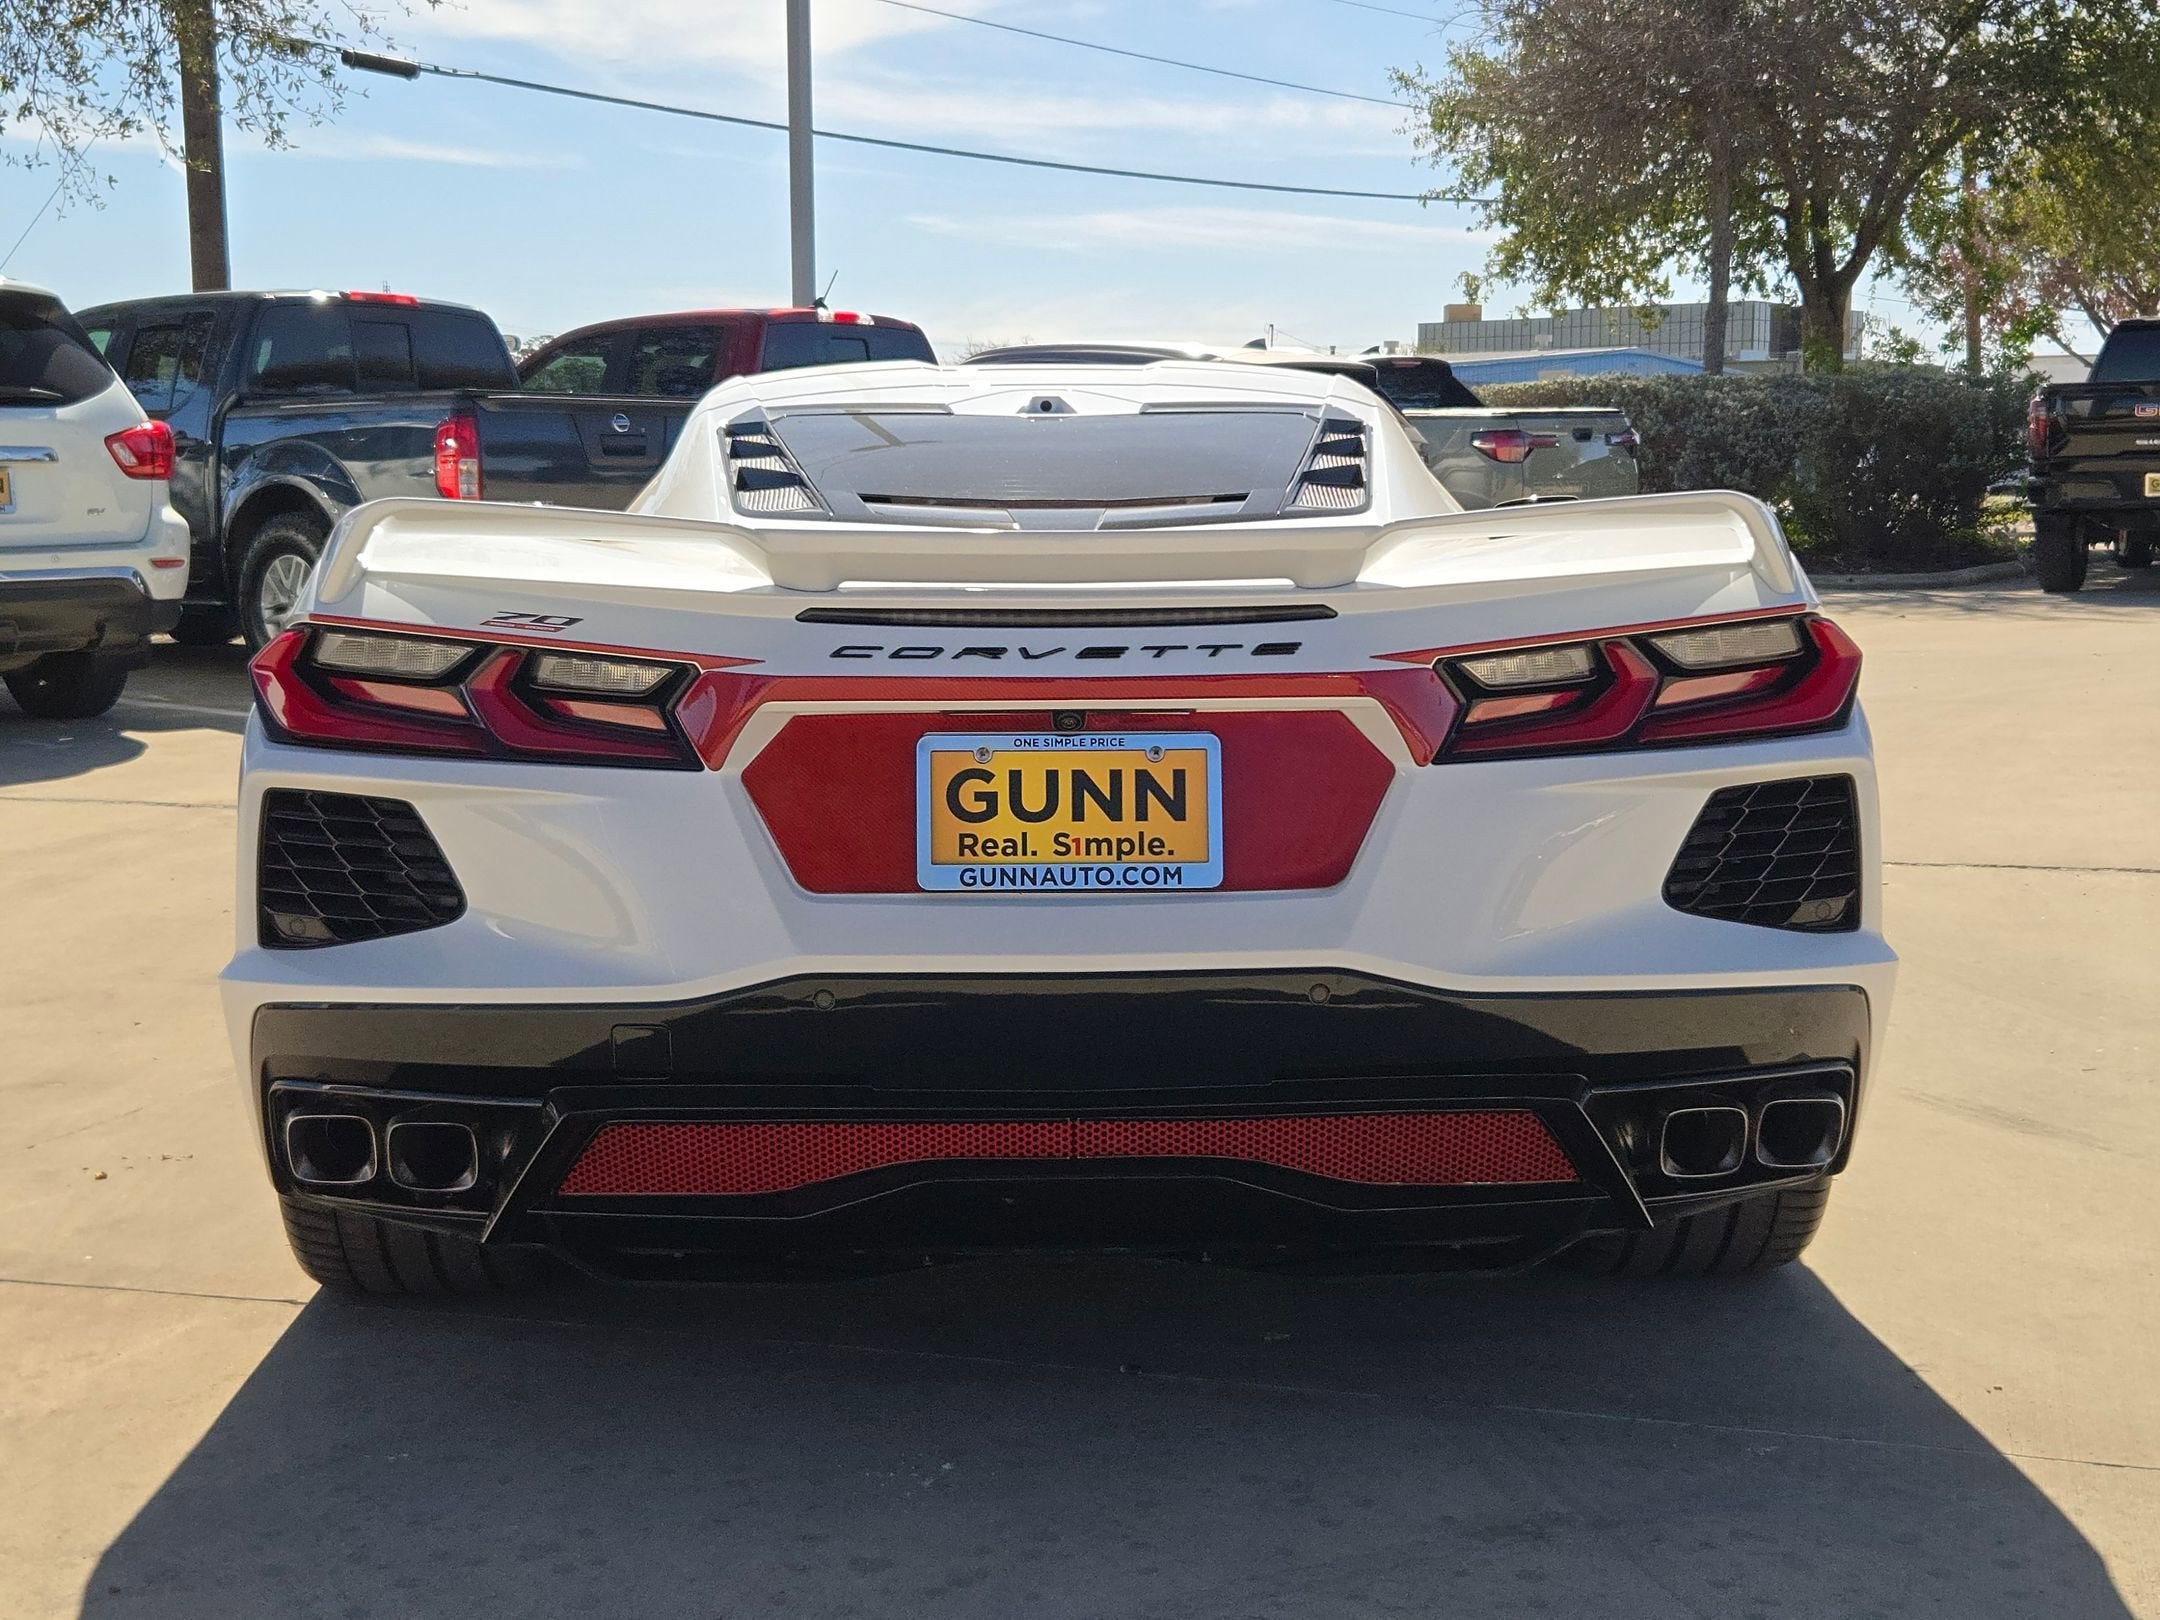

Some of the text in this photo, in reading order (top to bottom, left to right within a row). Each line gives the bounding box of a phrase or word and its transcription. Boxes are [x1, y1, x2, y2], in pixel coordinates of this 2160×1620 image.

[829, 642, 1303, 659] CORVETTE
[1013, 738, 1125, 747] ONE SIMPLE PRICE
[946, 768, 1187, 823] GUNN
[958, 832, 1038, 857] Real.
[959, 866, 1182, 887] GUNNAUTO.COM
